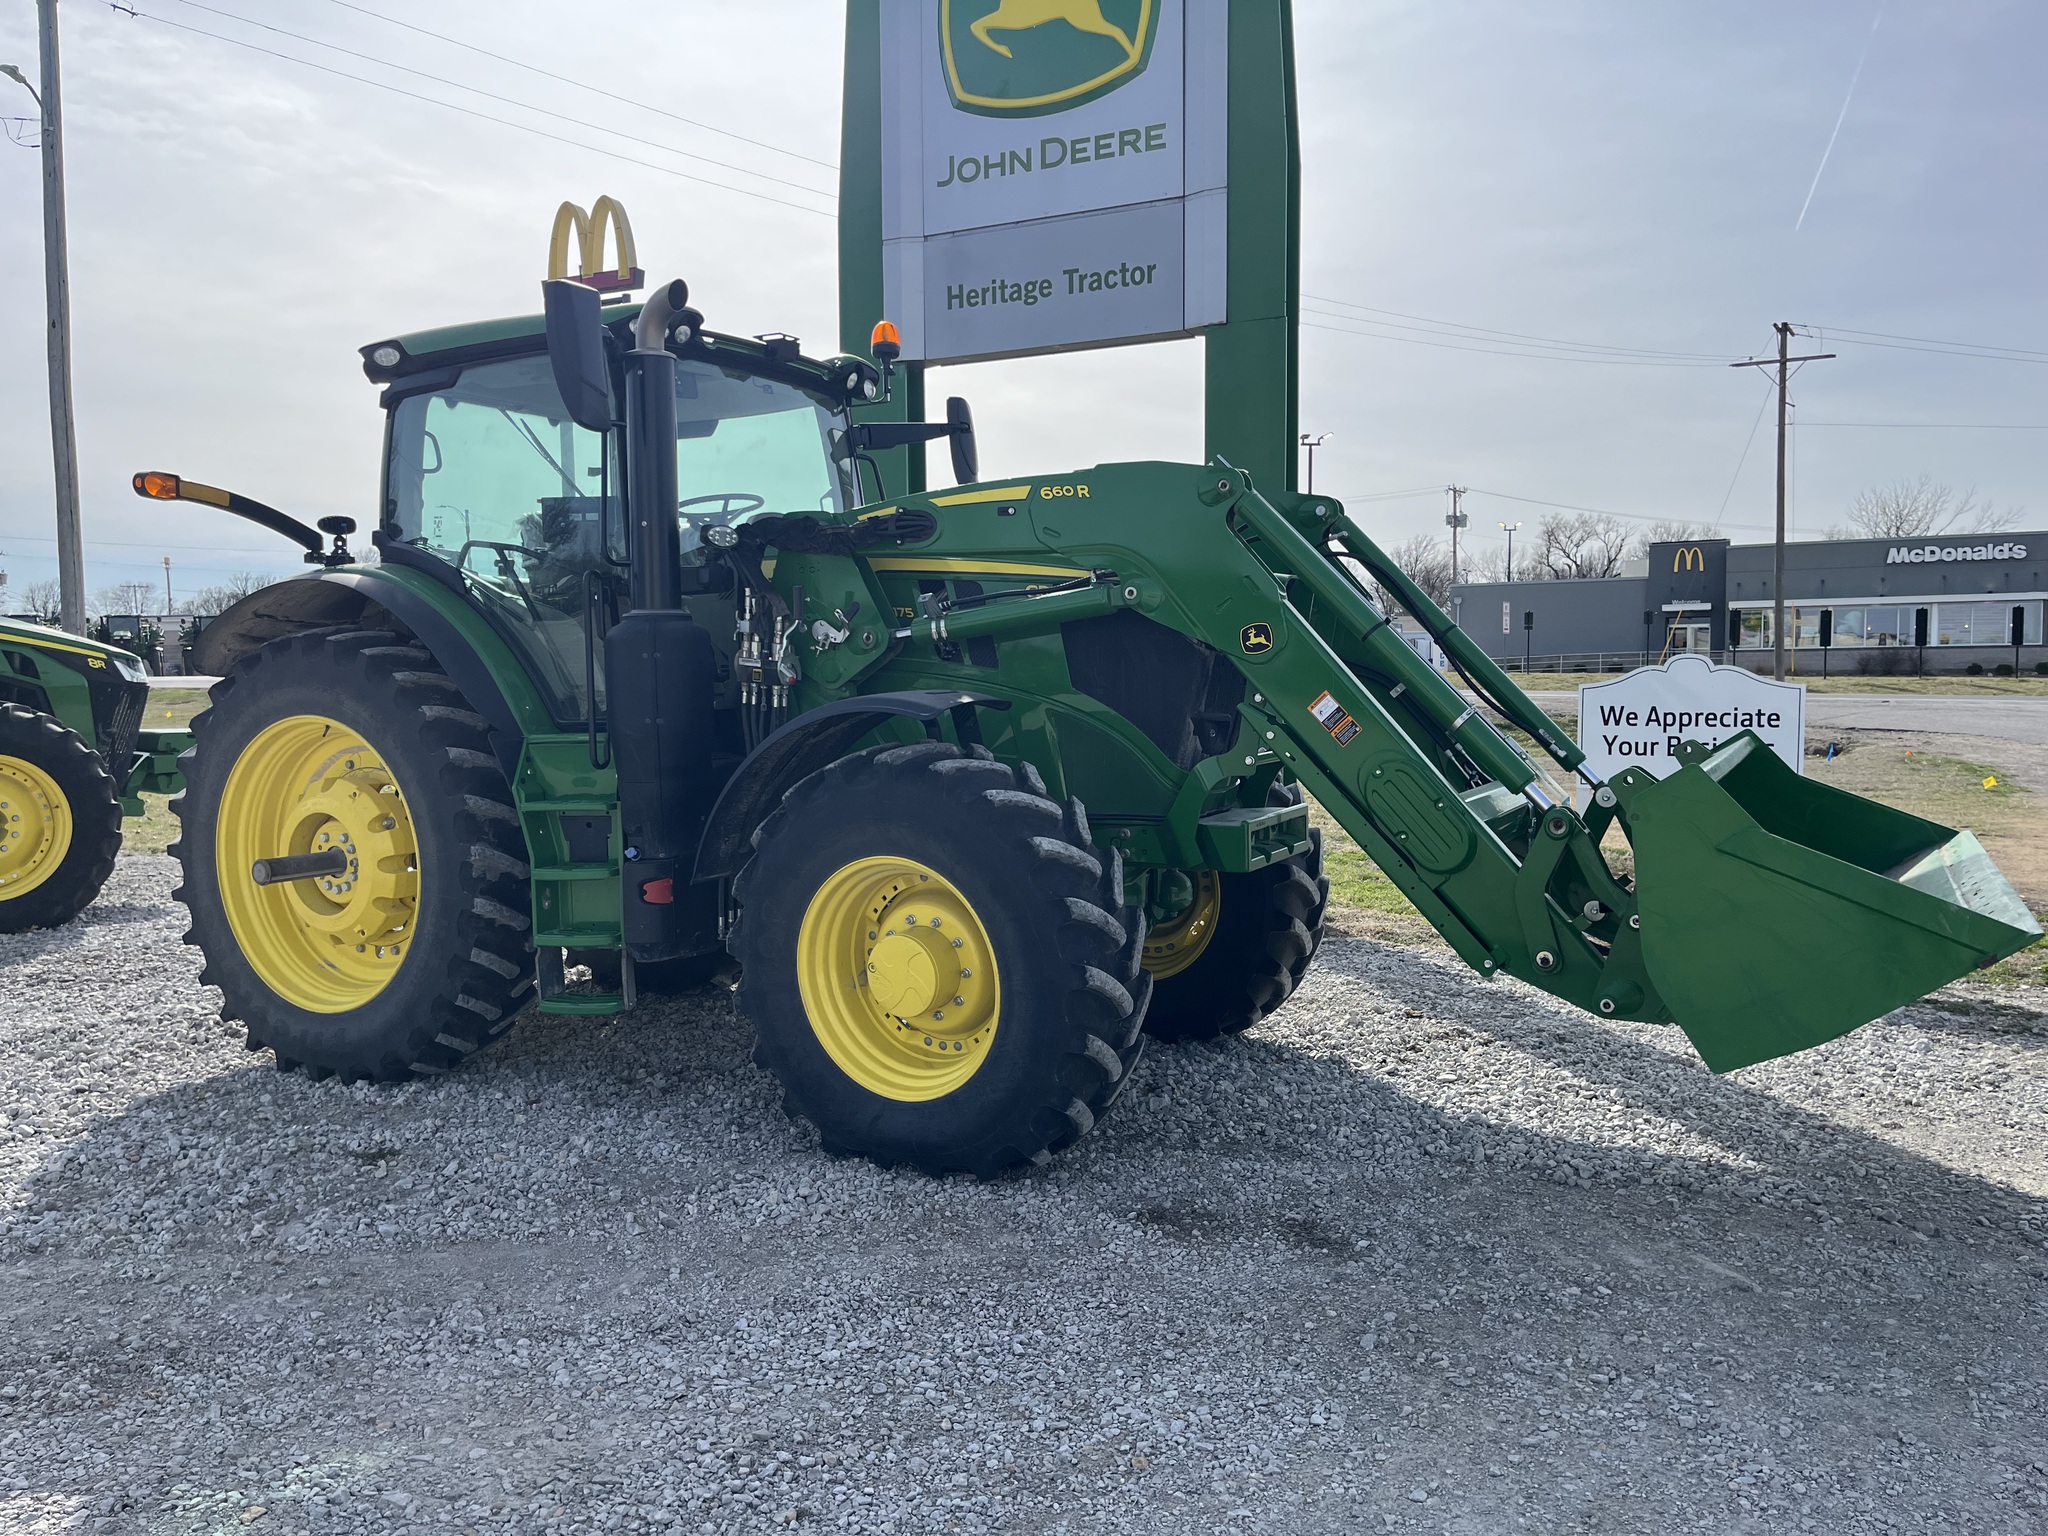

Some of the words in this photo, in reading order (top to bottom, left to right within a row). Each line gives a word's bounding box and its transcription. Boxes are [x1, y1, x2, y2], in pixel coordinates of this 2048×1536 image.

[937, 147, 1033, 188] JOHN
[1040, 122, 1168, 170] DEERE
[946, 278, 1054, 310] Heritage
[1062, 261, 1158, 295] Tractor
[1886, 542, 2028, 564] McDonald's
[87, 658, 107, 669] 8R
[1599, 705, 1639, 727] We
[1645, 705, 1781, 733] Appreciate
[1602, 734, 1660, 757] Your
